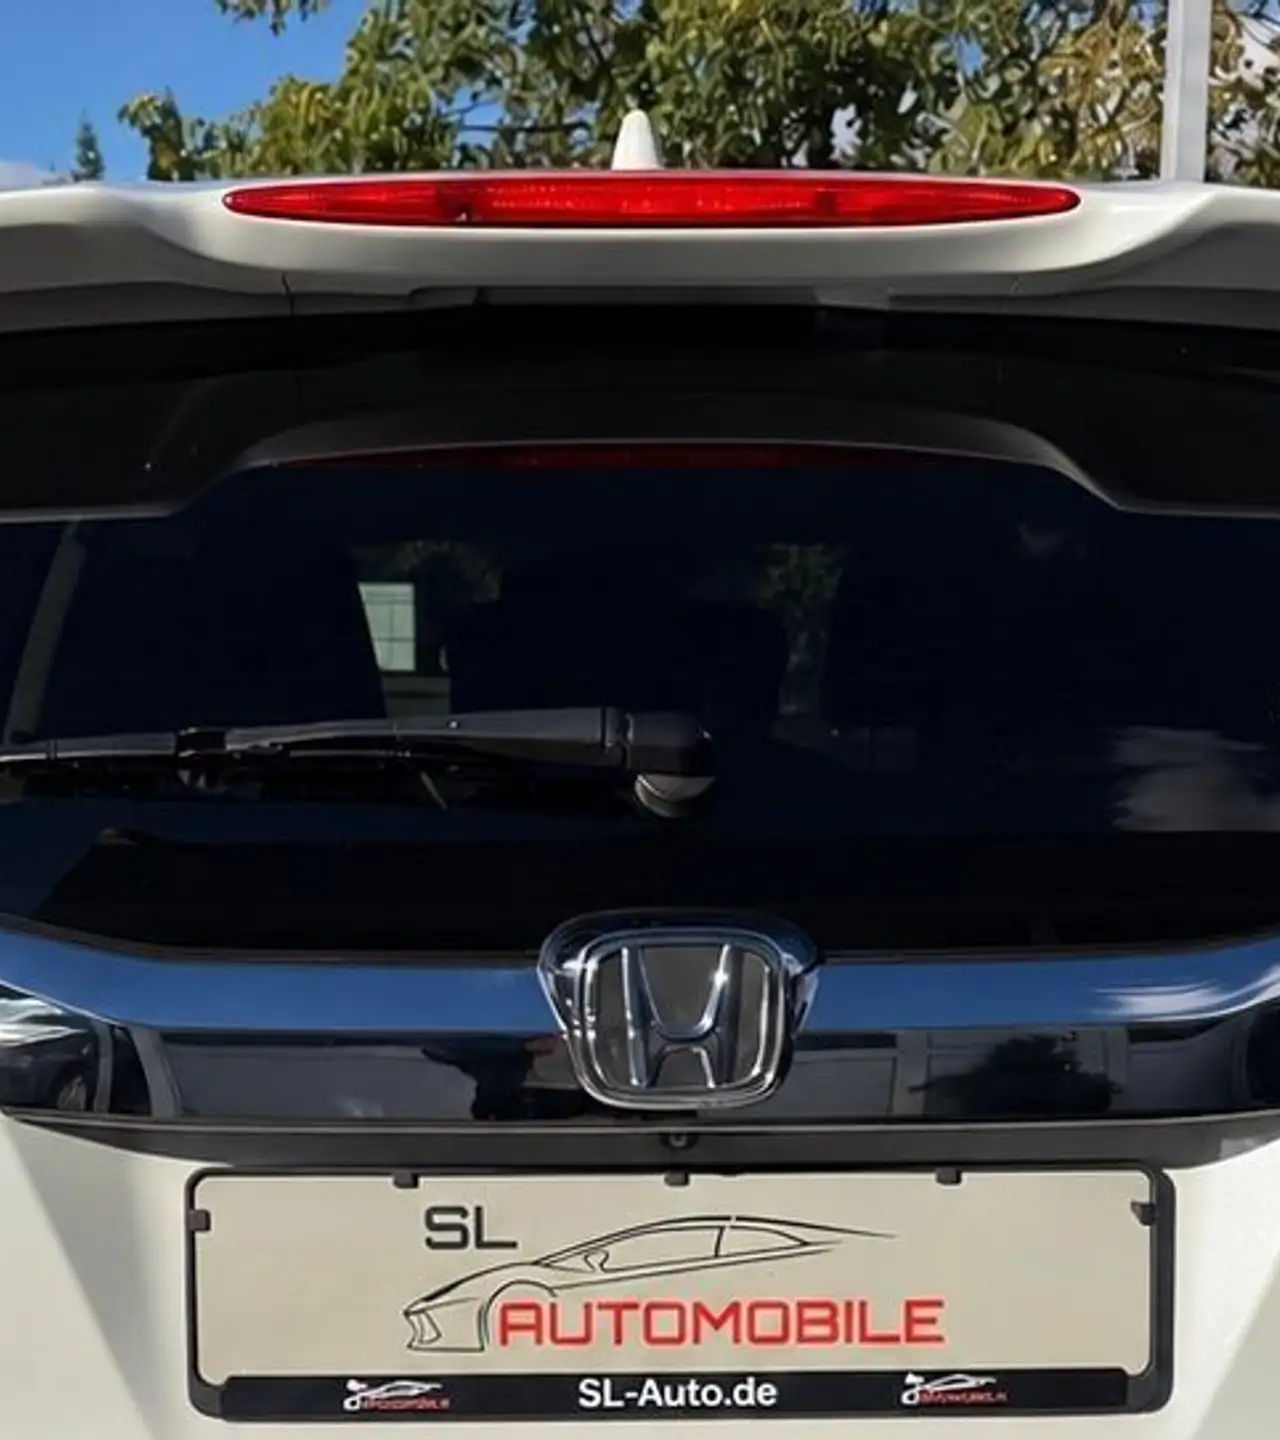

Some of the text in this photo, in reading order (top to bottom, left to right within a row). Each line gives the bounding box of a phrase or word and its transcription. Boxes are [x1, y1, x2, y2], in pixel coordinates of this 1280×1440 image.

[424, 1205, 518, 1251] SL
[498, 1299, 945, 1346] AUTOMOBILE
[577, 1377, 778, 1409] SL-Auto.de
